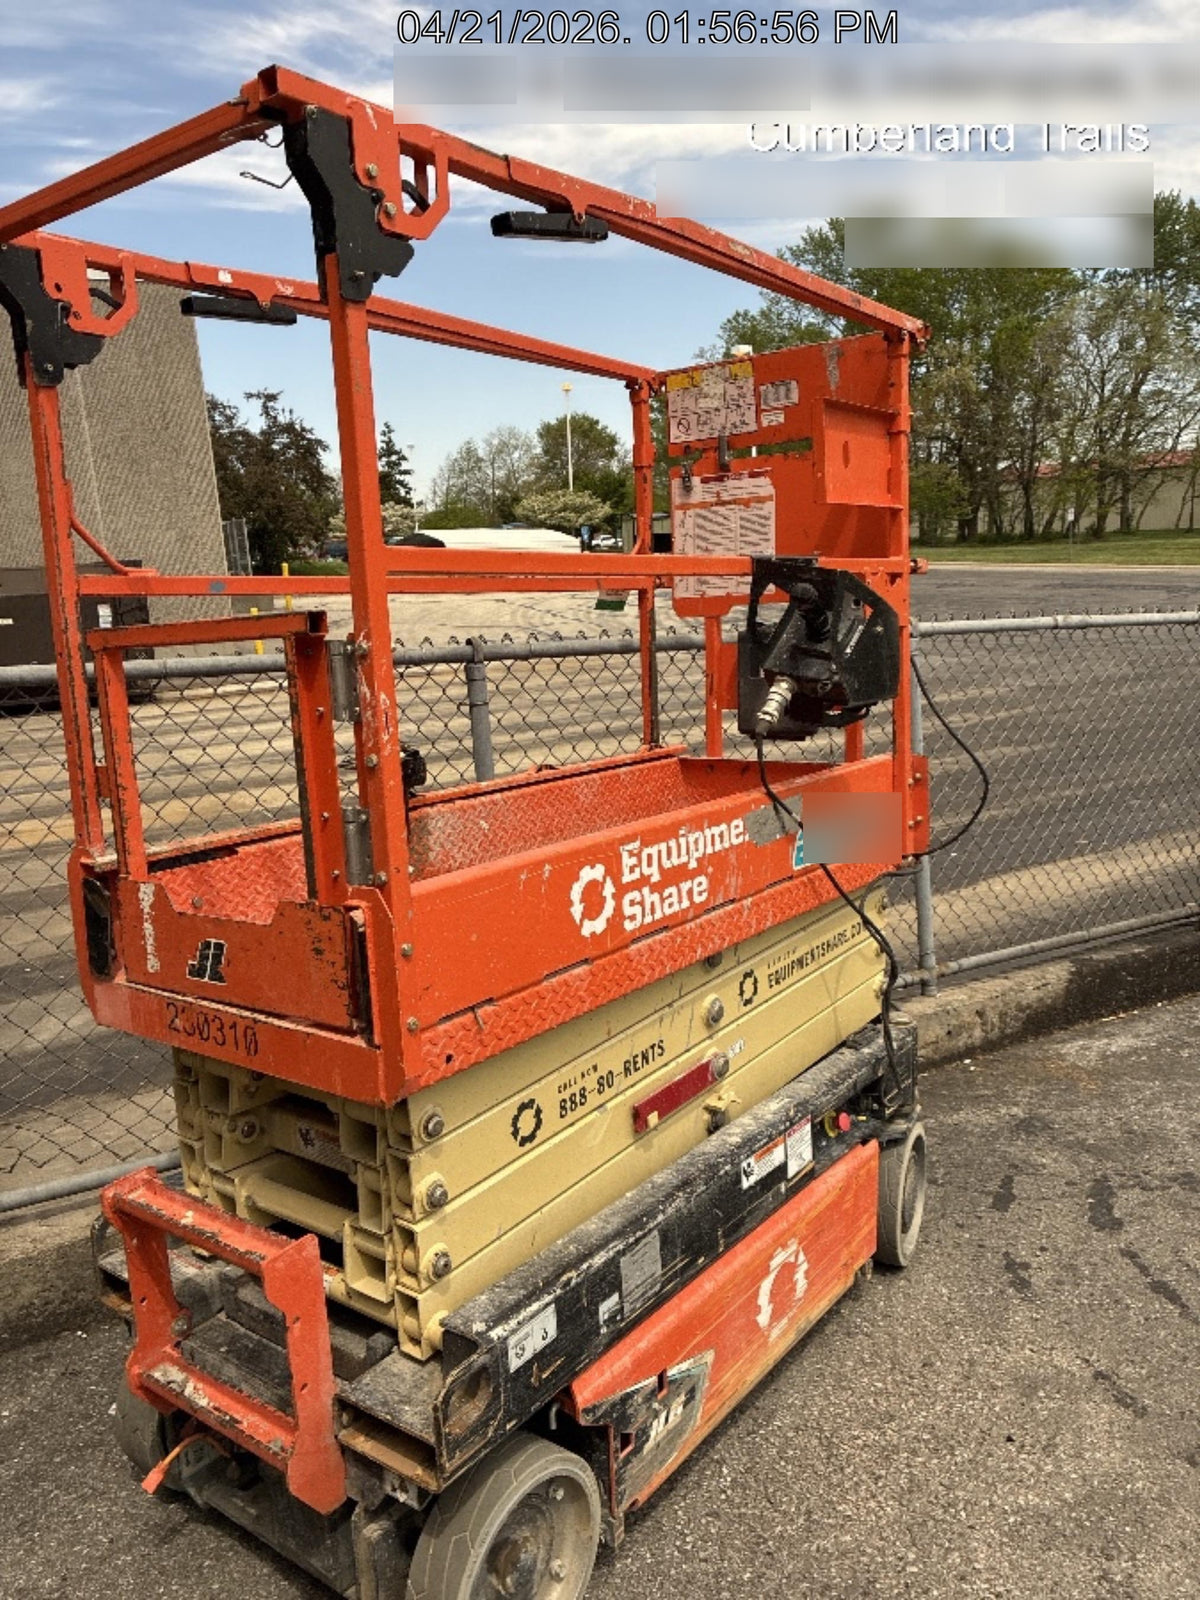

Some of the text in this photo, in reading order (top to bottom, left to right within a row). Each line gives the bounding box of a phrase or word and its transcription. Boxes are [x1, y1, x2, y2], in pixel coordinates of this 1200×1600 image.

[620, 817, 750, 884] Equipme
[622, 874, 708, 932] Share
[767, 921, 866, 989] EQUIPMENTSHARE.CO
[559, 1039, 666, 1119] 888-80-RENTS
